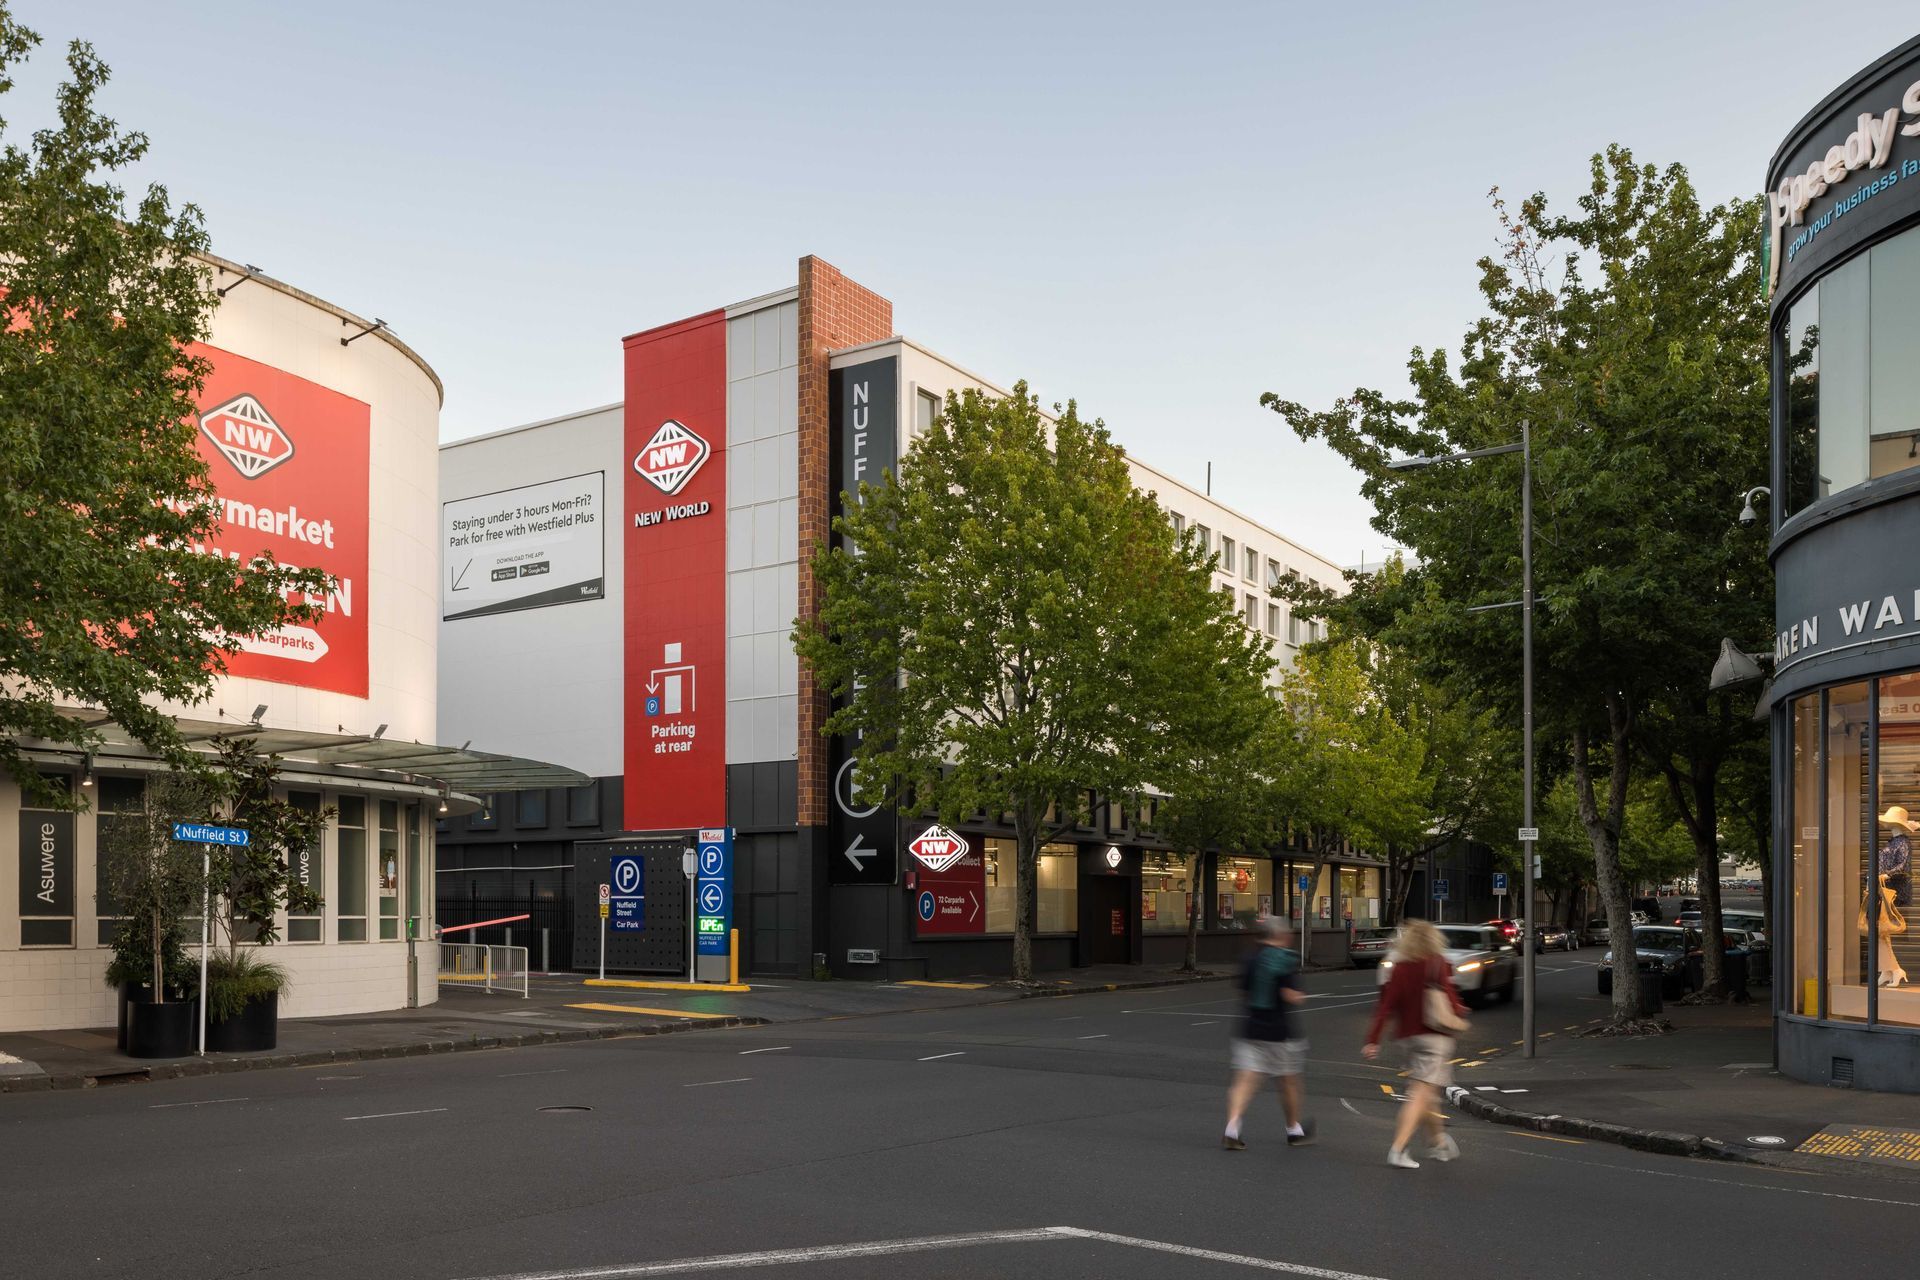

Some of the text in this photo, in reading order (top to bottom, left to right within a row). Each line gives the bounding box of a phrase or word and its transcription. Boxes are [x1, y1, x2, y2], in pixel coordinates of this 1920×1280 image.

[1809, 210, 1834, 242] your
[1836, 170, 1898, 218] business
[225, 420, 273, 453] NW
[650, 443, 687, 470] NW
[452, 494, 592, 531] Staying under 3 hours Mon-Fri?
[450, 512, 594, 547] Park for free with Westfield Plus
[496, 554, 524, 564] DOWNLOAD
[652, 721, 695, 738] Parking
[655, 740, 692, 754] at rear
[182, 826, 240, 843] Nuffield St
[922, 841, 950, 854] NW
[36, 823, 55, 903] Asuwere
[707, 852, 716, 868] P
[623, 866, 634, 886] P
[924, 900, 930, 913] P
